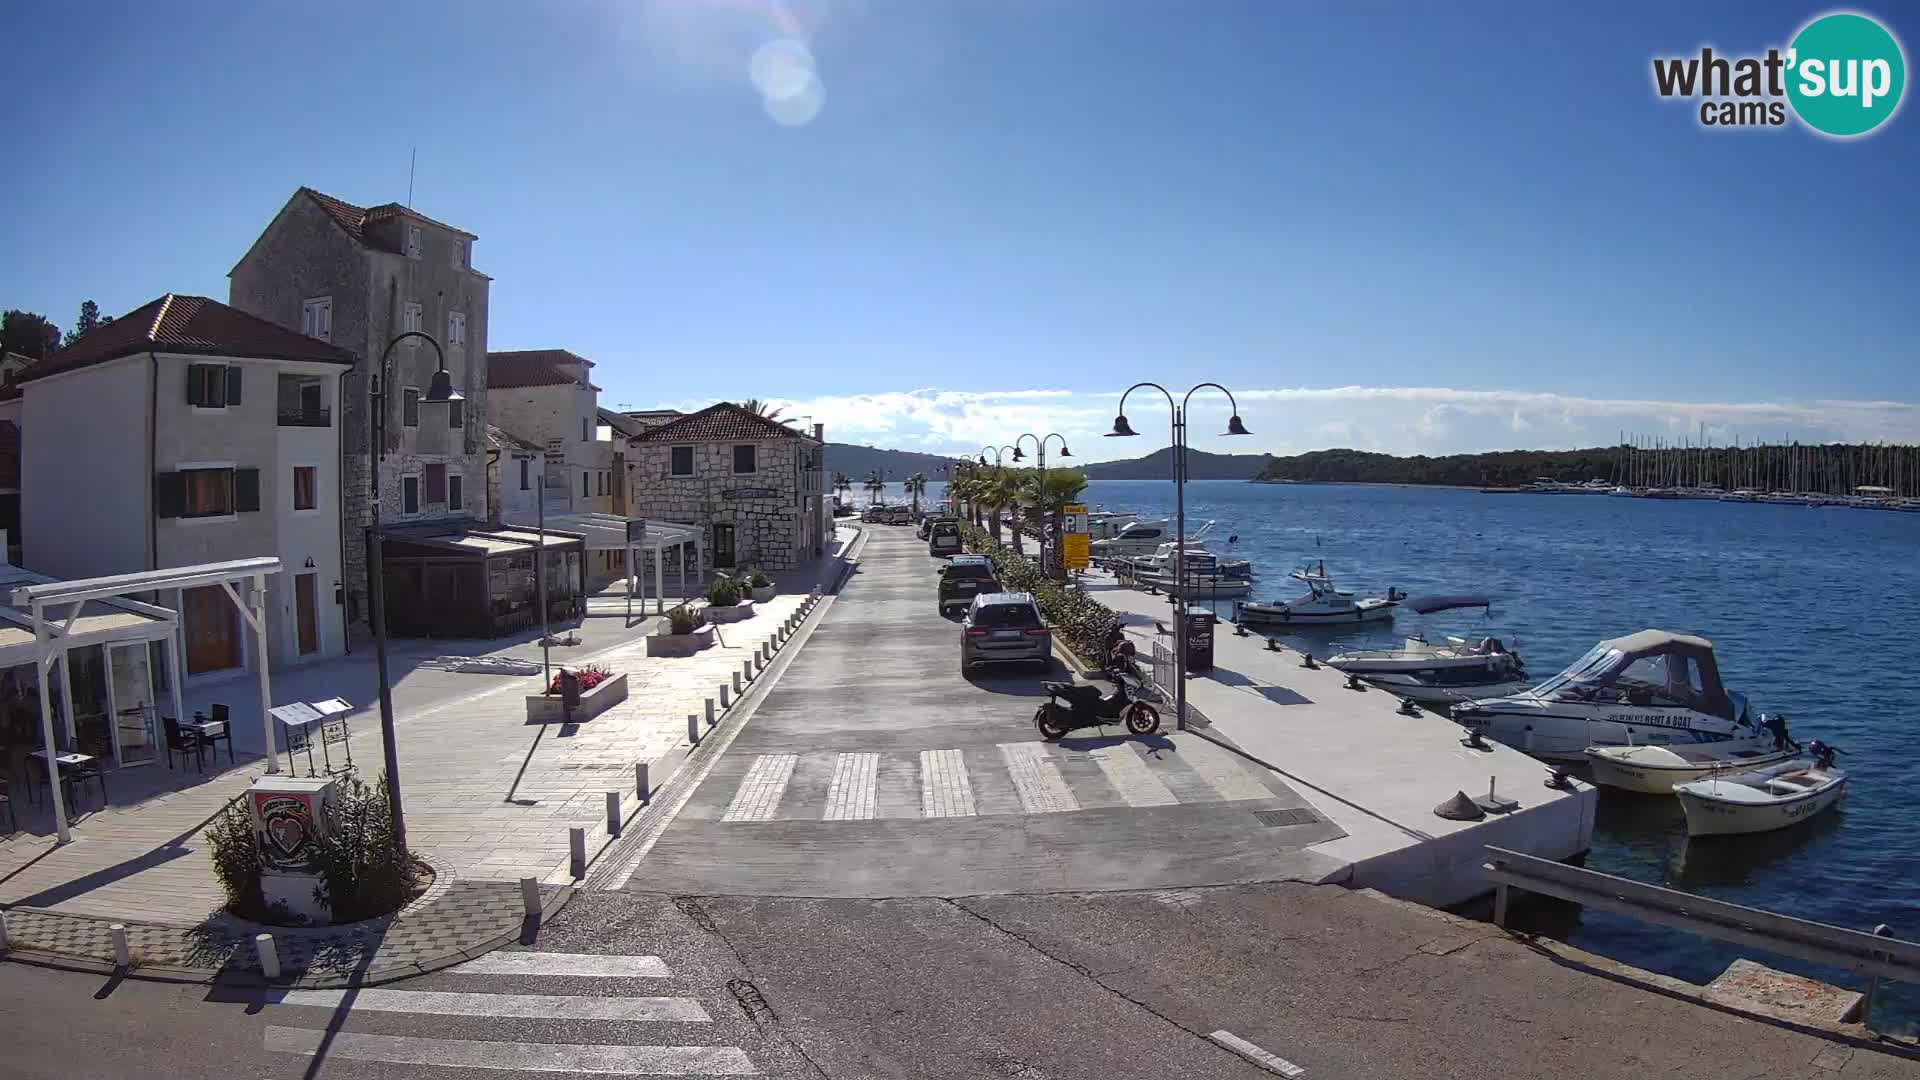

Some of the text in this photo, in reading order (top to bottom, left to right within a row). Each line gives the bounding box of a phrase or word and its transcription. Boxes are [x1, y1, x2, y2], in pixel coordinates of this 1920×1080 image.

[1065, 515, 1075, 532] P
[1645, 715, 1665, 725] RENT
[1665, 715, 1671, 725] A
[1672, 715, 1692, 728] BOAT
